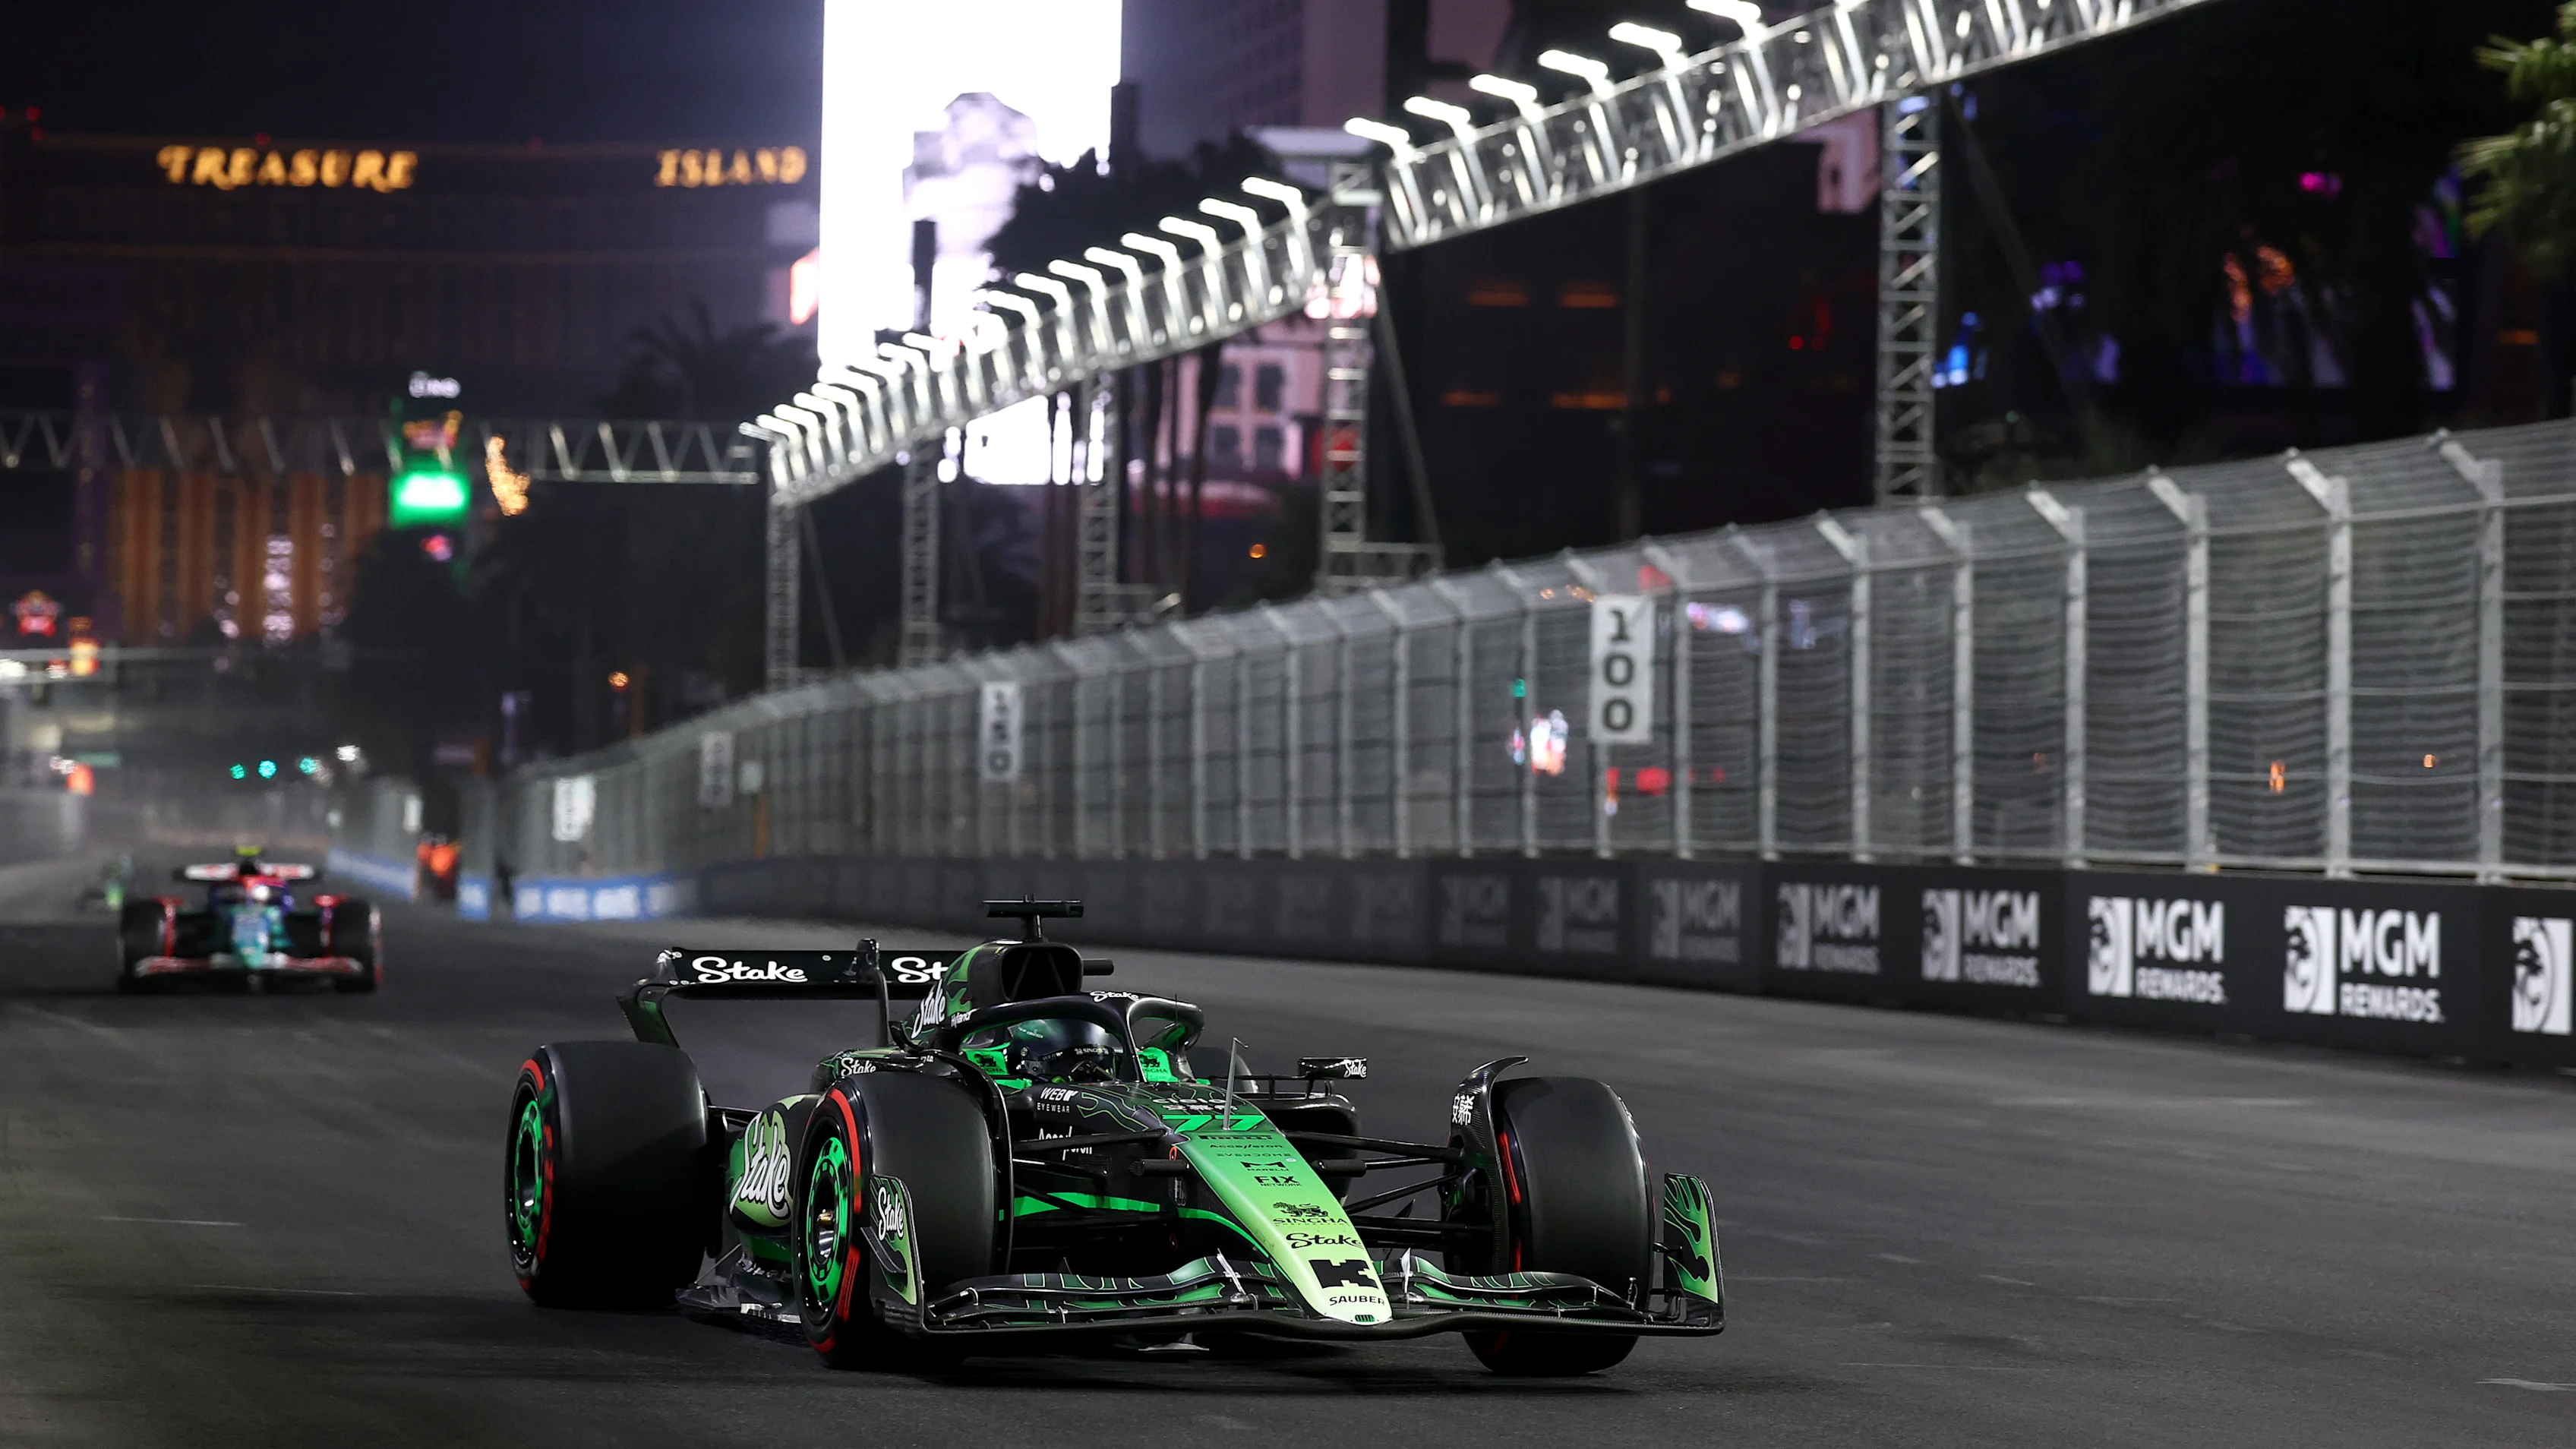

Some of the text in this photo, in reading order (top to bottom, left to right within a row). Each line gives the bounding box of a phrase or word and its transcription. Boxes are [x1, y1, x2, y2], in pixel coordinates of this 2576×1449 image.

[156, 144, 807, 193] TREASURE ISLAND
[1602, 609, 1635, 731] 100
[1814, 883, 1880, 938] MGM
[1963, 889, 2039, 949] MGM
[2136, 898, 2224, 963] MGM
[2341, 908, 2440, 977] MGM
[692, 956, 808, 983] Stake
[911, 978, 946, 1039] Stake
[1089, 991, 1139, 1002] Stake
[841, 1057, 876, 1077] Stake
[1343, 1059, 1367, 1078] Stake
[1037, 1102, 1070, 1113] EYEWEAR
[1163, 1114, 1265, 1132] 77
[729, 1111, 791, 1217] Stake
[878, 1186, 904, 1241] Stake
[1286, 1233, 1365, 1249] Stake
[1330, 1295, 1384, 1305] SAUBER
